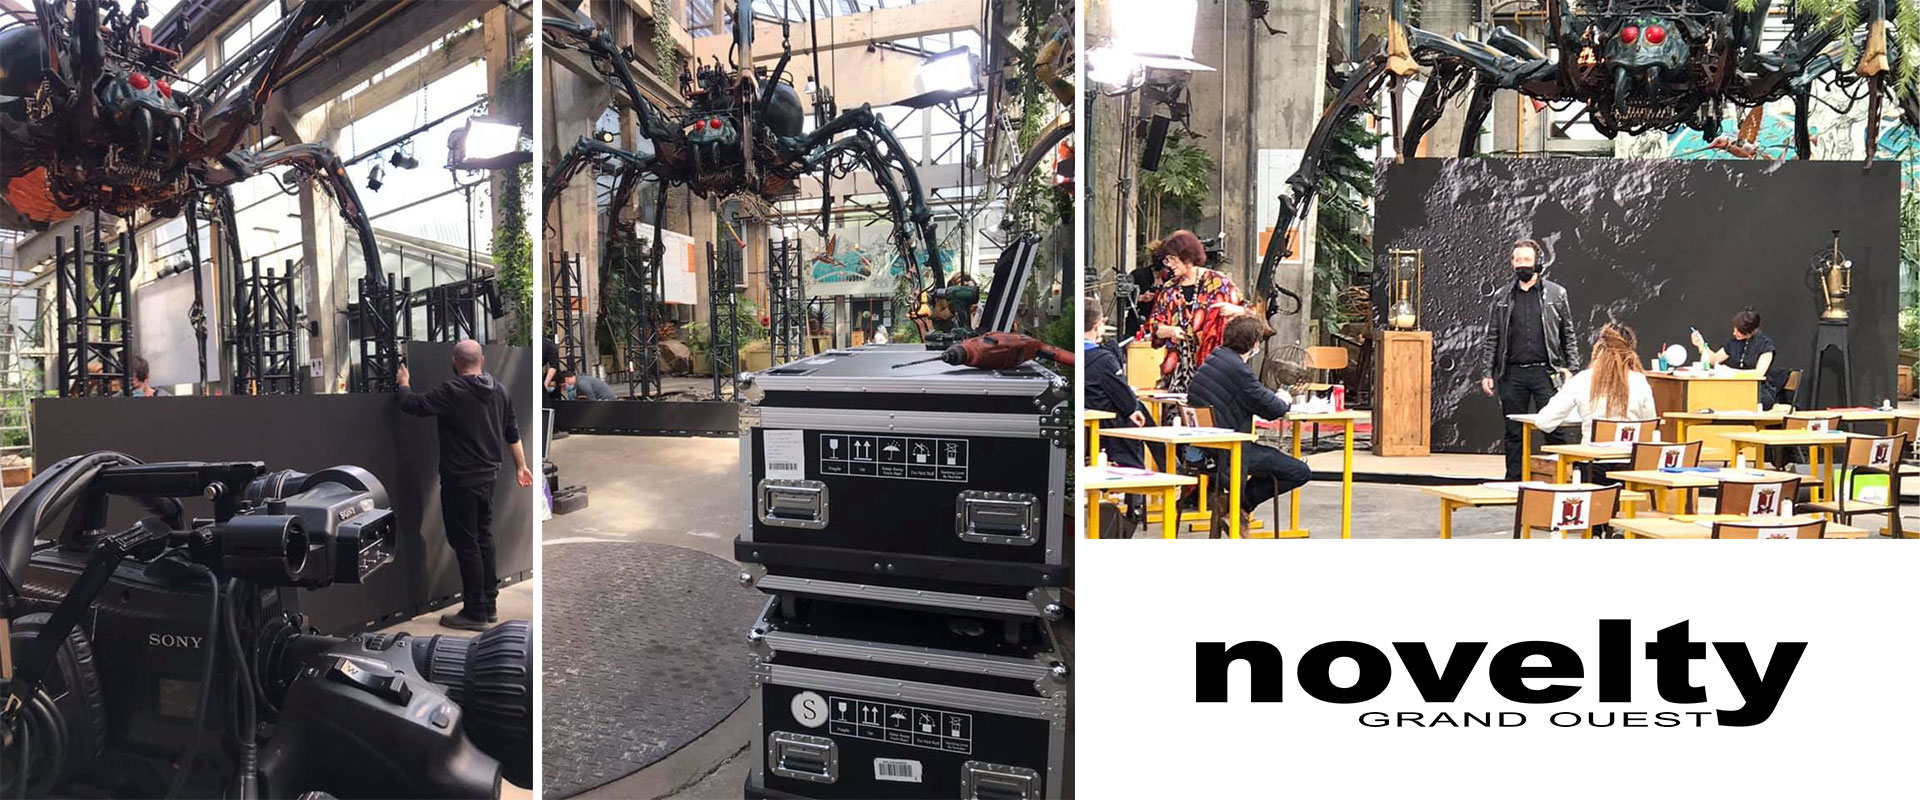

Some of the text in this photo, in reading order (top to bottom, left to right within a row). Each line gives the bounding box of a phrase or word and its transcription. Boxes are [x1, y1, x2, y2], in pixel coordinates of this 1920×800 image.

[149, 633, 203, 649] SONY
[347, 665, 359, 675] W
[803, 699, 817, 720] S
